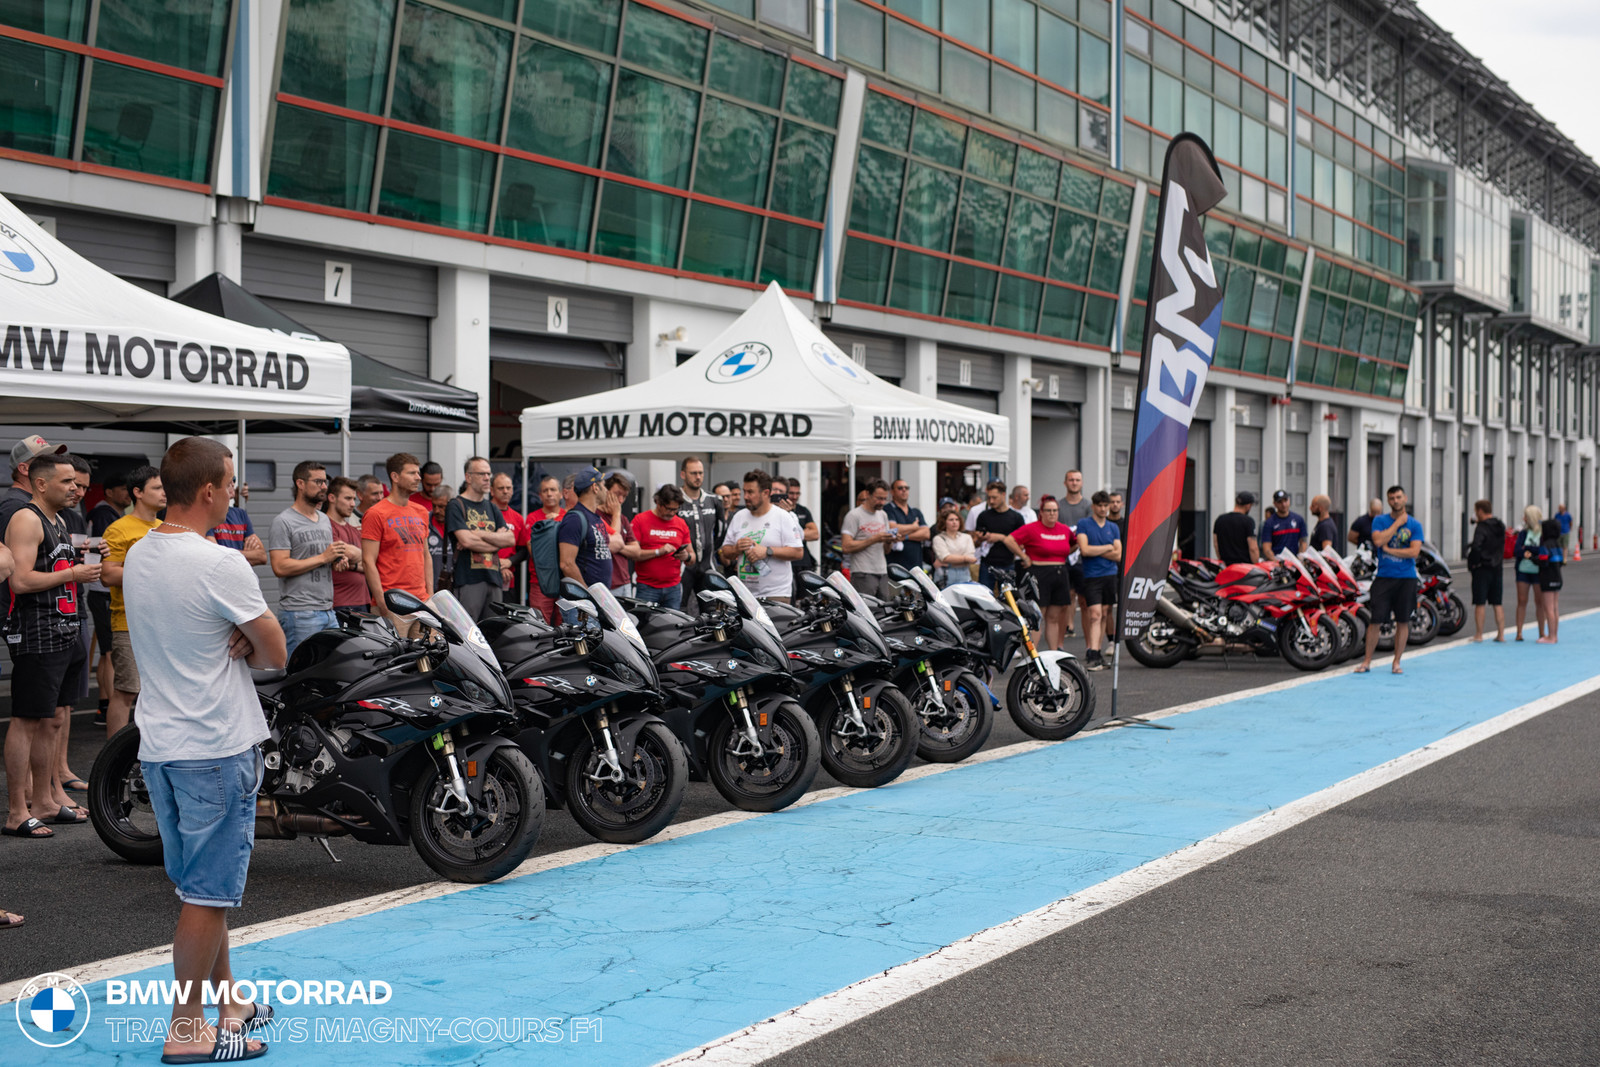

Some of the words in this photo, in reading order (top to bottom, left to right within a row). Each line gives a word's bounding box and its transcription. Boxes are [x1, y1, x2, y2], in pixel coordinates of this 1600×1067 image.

[332, 265, 344, 297] 7
[552, 300, 563, 329] 8
[85, 332, 310, 391] MOTORRAD
[557, 414, 630, 441] BMW
[638, 411, 813, 439] MOTORRAD
[872, 414, 912, 441] BMW
[915, 417, 995, 447] MOTORRAD
[650, 529, 677, 538] DUCATI
